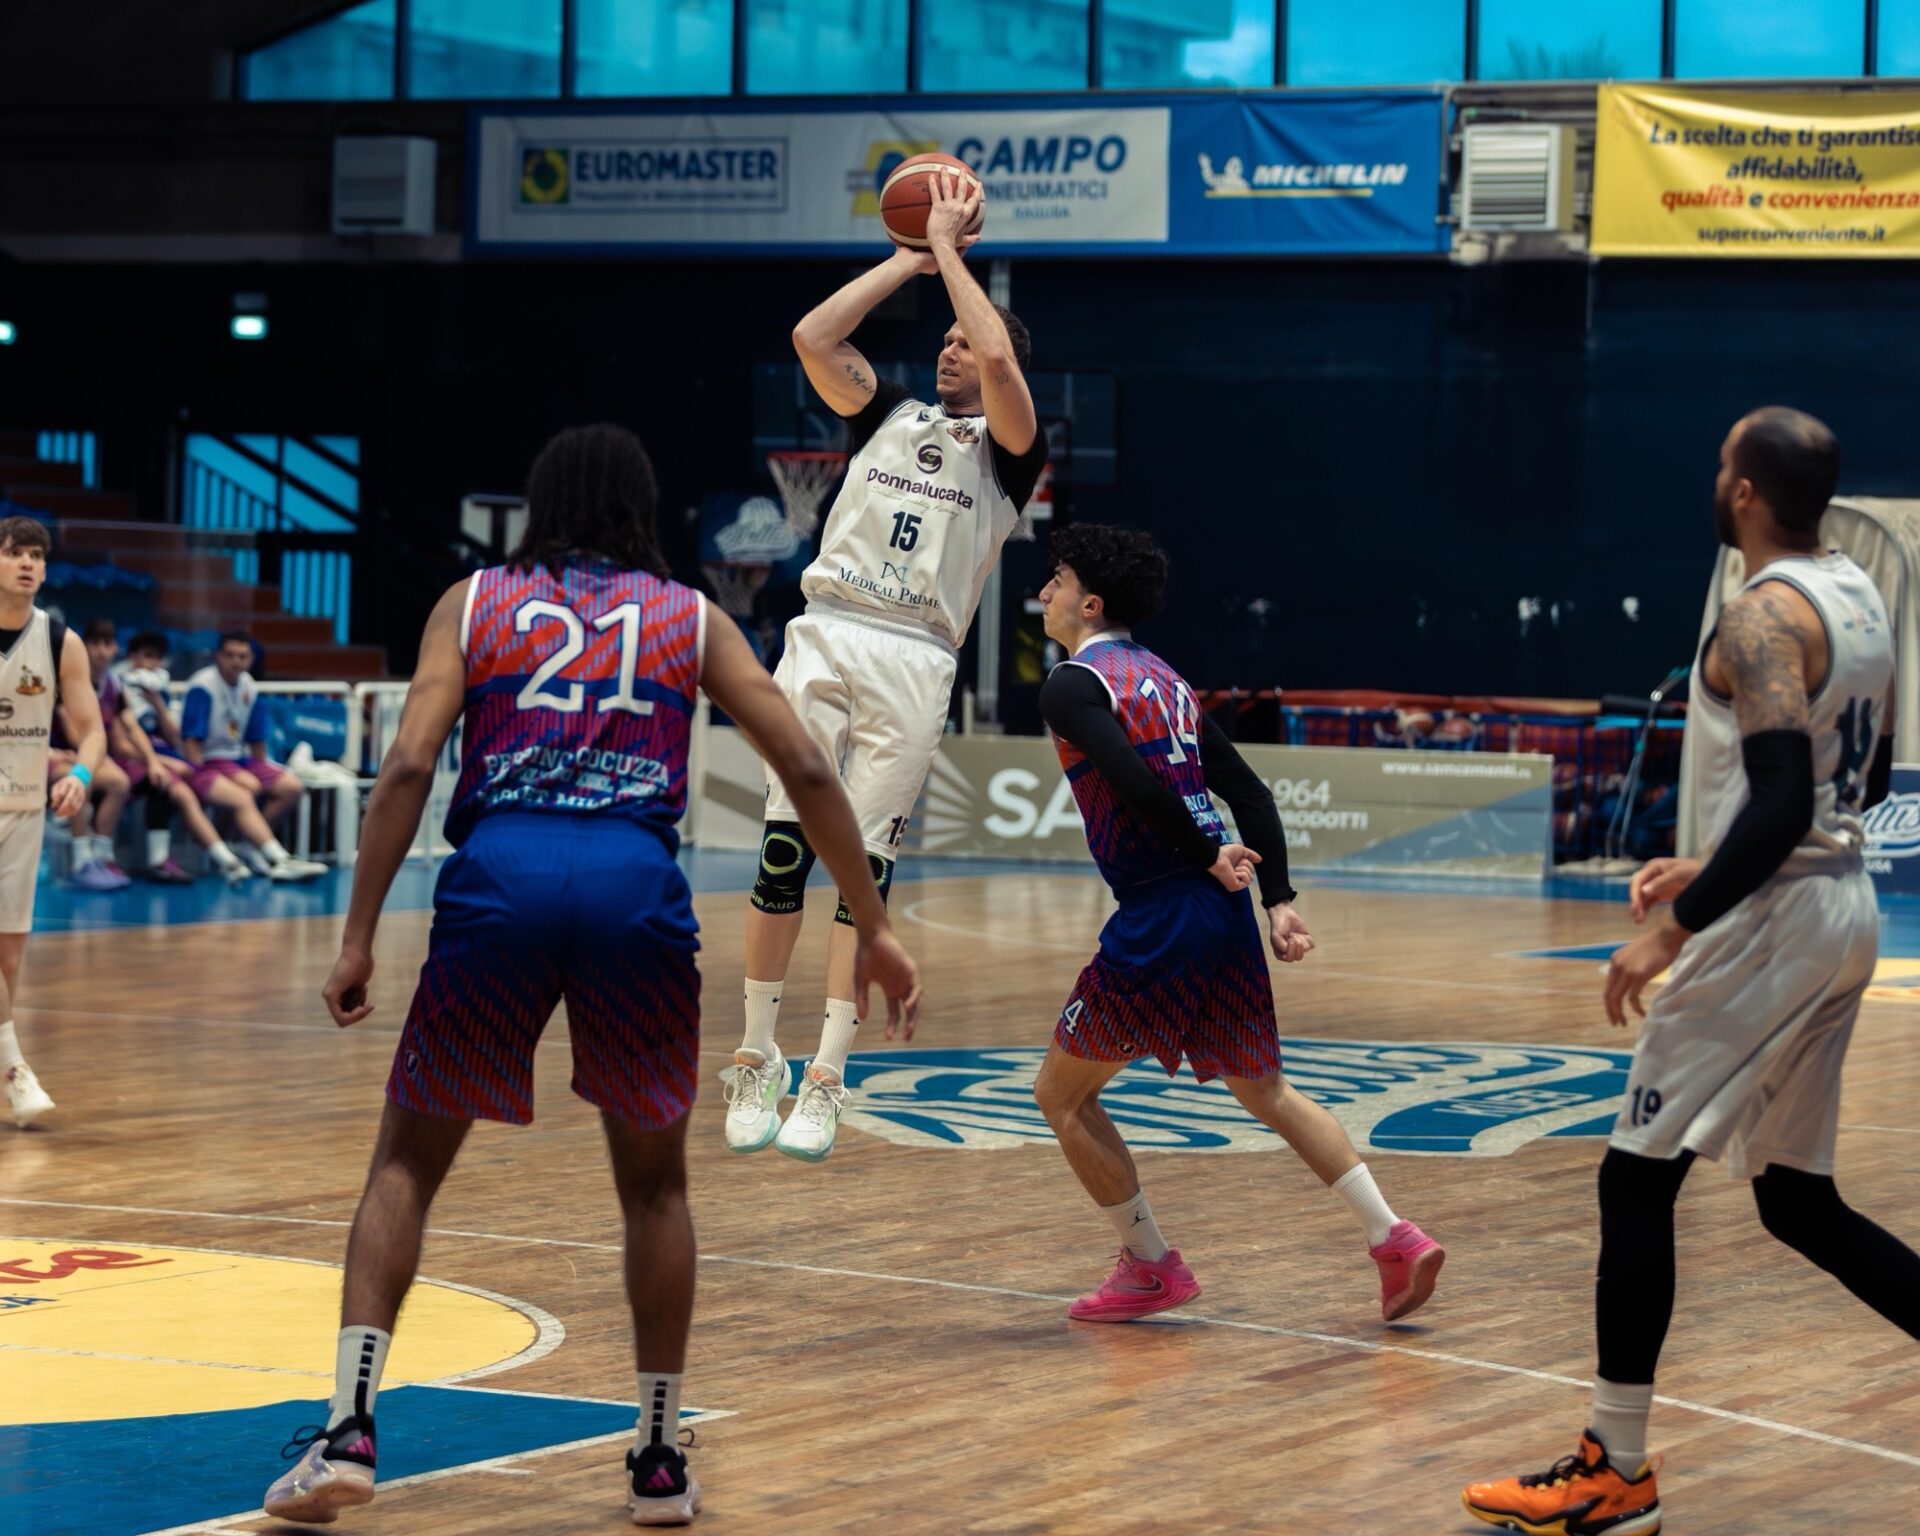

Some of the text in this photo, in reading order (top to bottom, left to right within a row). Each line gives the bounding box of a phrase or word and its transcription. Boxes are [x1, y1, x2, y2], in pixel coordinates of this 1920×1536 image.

[1650, 123, 1676, 145] La
[1682, 124, 1746, 145] scelta
[1751, 126, 1790, 145] che
[1797, 127, 1813, 145] ti
[575, 150, 777, 181] EUROMASTER
[954, 134, 1127, 174] CAMPO
[1253, 164, 1408, 185] MICHELIN
[982, 179, 1108, 201] NEUMATICI
[1660, 184, 1920, 212] qualità e convenienza
[1697, 224, 1885, 242] superconveniente.it
[867, 467, 974, 510] Donnalucata
[889, 510, 923, 552] 15
[515, 598, 654, 715] 21
[1139, 677, 1203, 765] 14
[576, 746, 669, 787] COCUZZA
[1260, 778, 1331, 808] 964
[1278, 809, 1369, 831] RODOTTI
[752, 890, 796, 911] GIBAUD
[1631, 1085, 1663, 1127] 19
